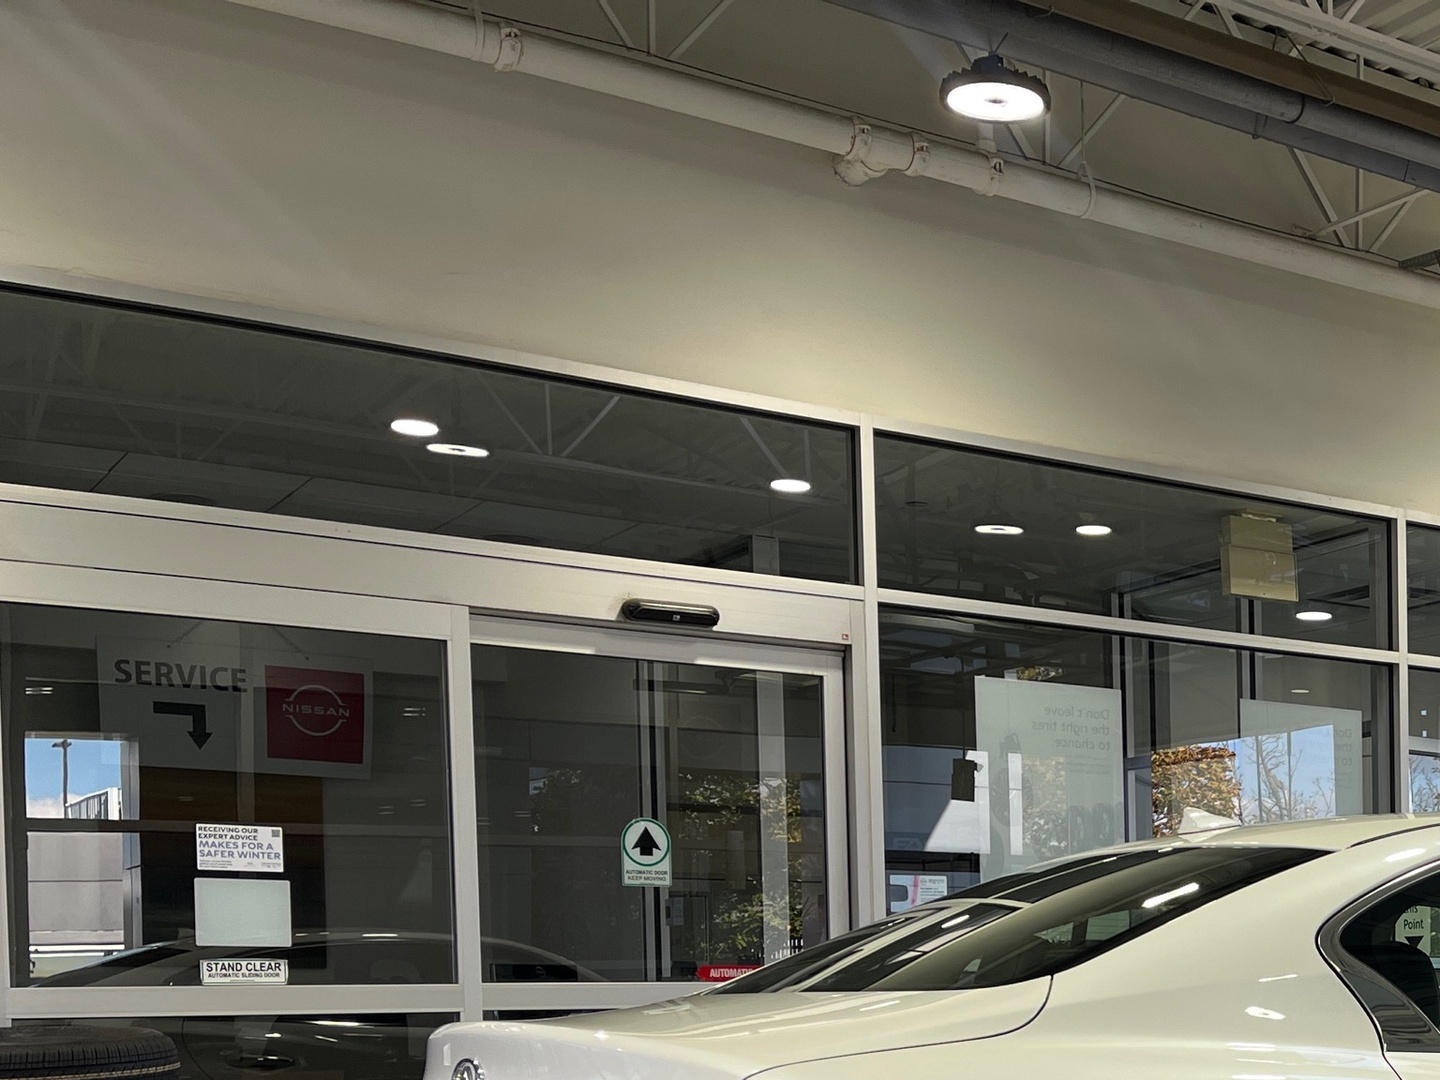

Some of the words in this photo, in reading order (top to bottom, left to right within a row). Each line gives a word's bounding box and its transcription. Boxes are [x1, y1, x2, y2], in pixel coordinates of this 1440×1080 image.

[114, 659, 248, 693] SERVICE
[282, 703, 350, 717] NISSAN
[197, 826, 240, 834] RECEIVING
[198, 840, 240, 849] MAKES
[241, 841, 264, 850] FOR
[199, 849, 235, 858] SAFER
[237, 851, 281, 860] WINTER
[1403, 918, 1425, 930] Point
[206, 962, 243, 972] STAND
[245, 962, 282, 972] CLEAR
